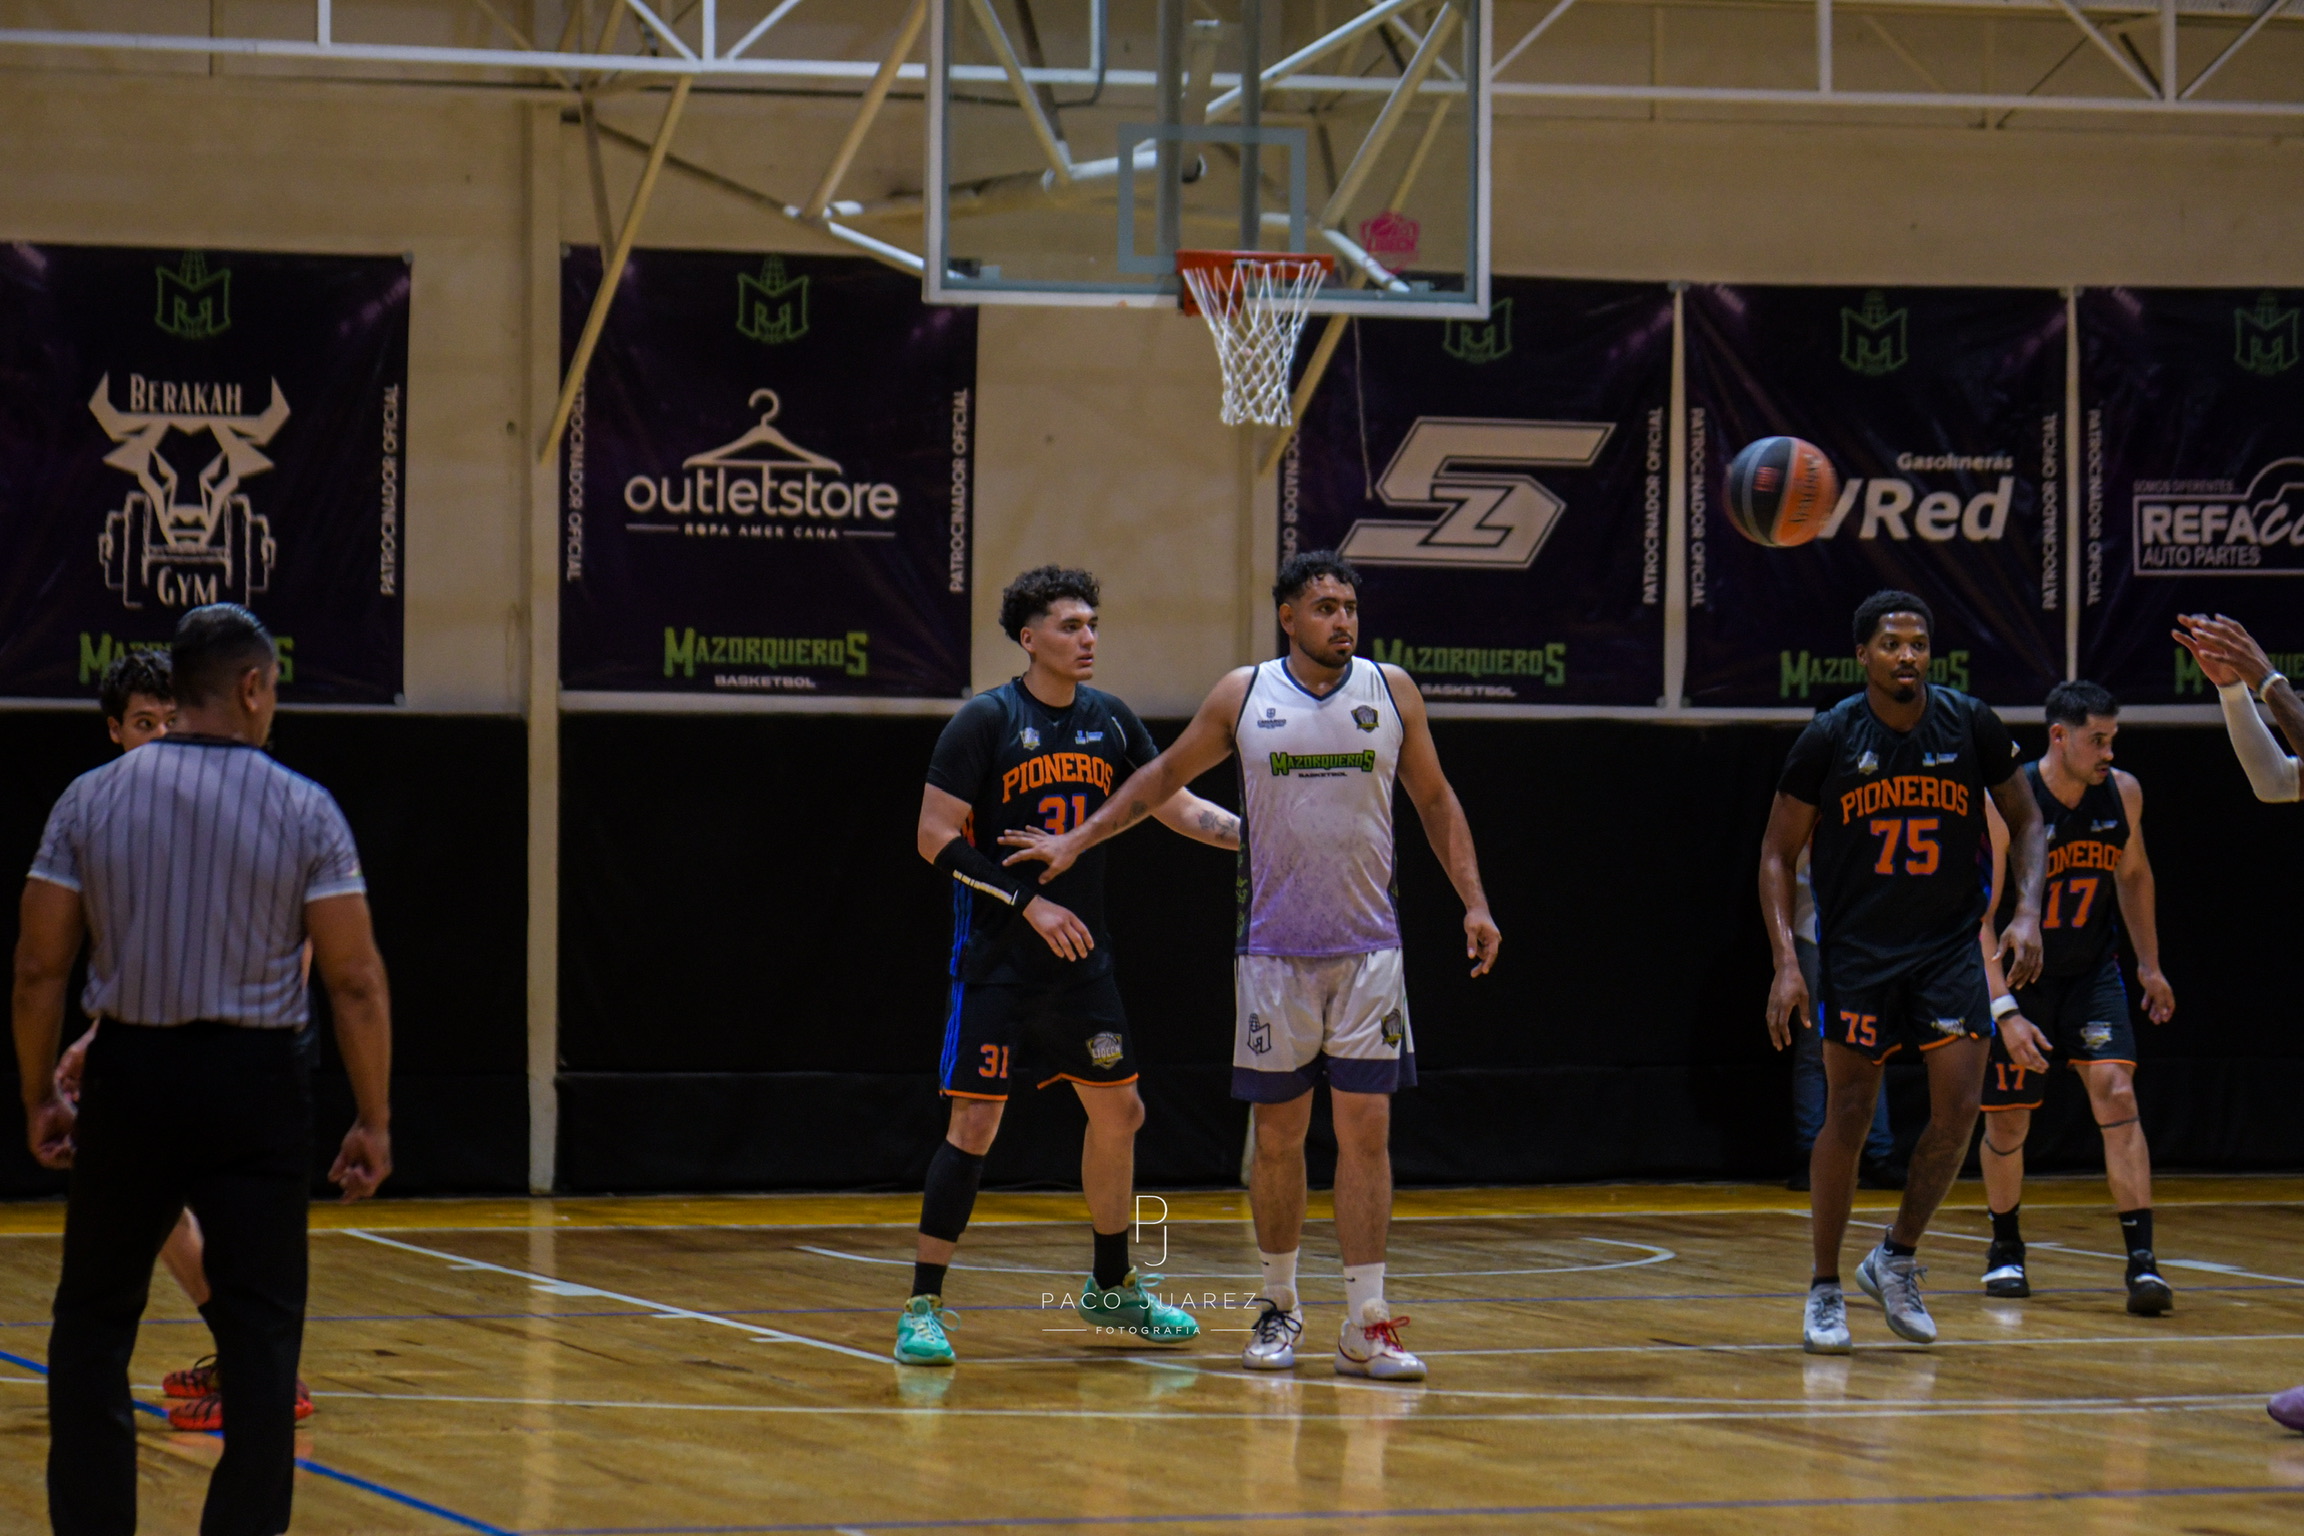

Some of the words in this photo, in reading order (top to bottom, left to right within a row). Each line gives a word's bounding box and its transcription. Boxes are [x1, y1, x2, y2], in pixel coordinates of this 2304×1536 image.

[129, 372, 242, 415] BERAKAH
[382, 383, 399, 454] OFICIAL
[952, 387, 968, 455] OFICIAL
[569, 378, 586, 511] TROCINADOR
[1646, 406, 1664, 473] OFICIAL
[1896, 451, 2014, 472] Gasolineras
[2041, 411, 2058, 479] OFICIAL
[624, 464, 900, 520] outletstore
[1690, 407, 1706, 539] PATROCINADOR
[2088, 408, 2103, 539] PATROCINADOR
[380, 456, 397, 595] PATROCINADOR
[567, 512, 583, 582] OFICIAL
[949, 457, 966, 594] PATROCINADOR
[1642, 475, 1661, 605] PATROCINADOR
[2041, 480, 2058, 610] PATROCINADOR
[156, 565, 218, 607] GYM
[1690, 541, 1706, 607] OFICIAL
[2087, 540, 2103, 607] OFICIAL
[2142, 545, 2191, 567] AUTO
[2194, 545, 2261, 567] PARTES
[664, 626, 869, 679] MAZORQUEROS
[714, 674, 817, 688] BASKETBOL
[1002, 752, 1114, 804] PIONEROS
[1270, 749, 1375, 776] MAZORQUEROS
[1839, 775, 1969, 826] PIONEROS
[1870, 815, 1941, 875] 75
[2042, 877, 2099, 929] 17
[1840, 1010, 1877, 1047] 75
[978, 1044, 1010, 1078] 31
[1995, 1063, 2026, 1091] 17
